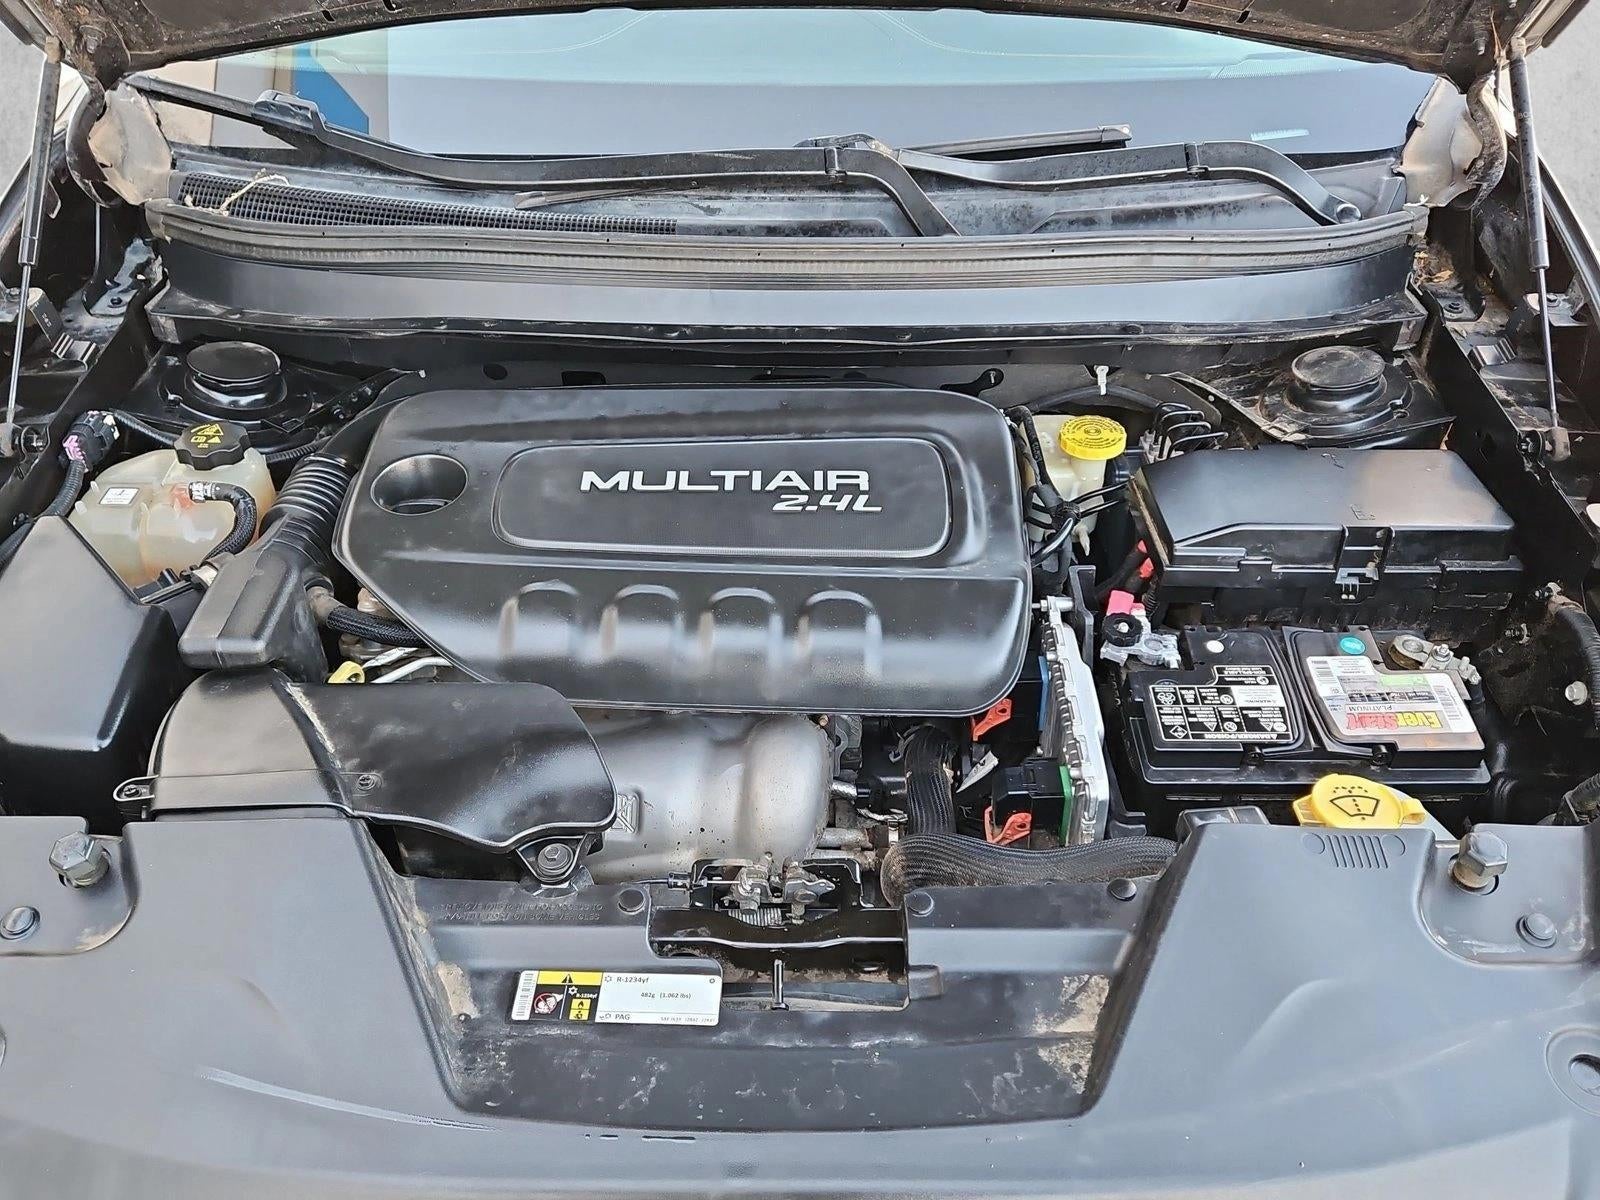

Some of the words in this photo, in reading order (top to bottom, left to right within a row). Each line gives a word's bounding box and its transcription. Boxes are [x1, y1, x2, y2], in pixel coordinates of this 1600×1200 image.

[580, 470, 870, 492] MULTIAIR
[771, 494, 882, 513] 2.4L
[1348, 704, 1393, 712] PLATINUM
[1346, 711, 1443, 731] EverStart
[616, 976, 649, 985] R-1234yf
[615, 1013, 631, 1021] PAG
